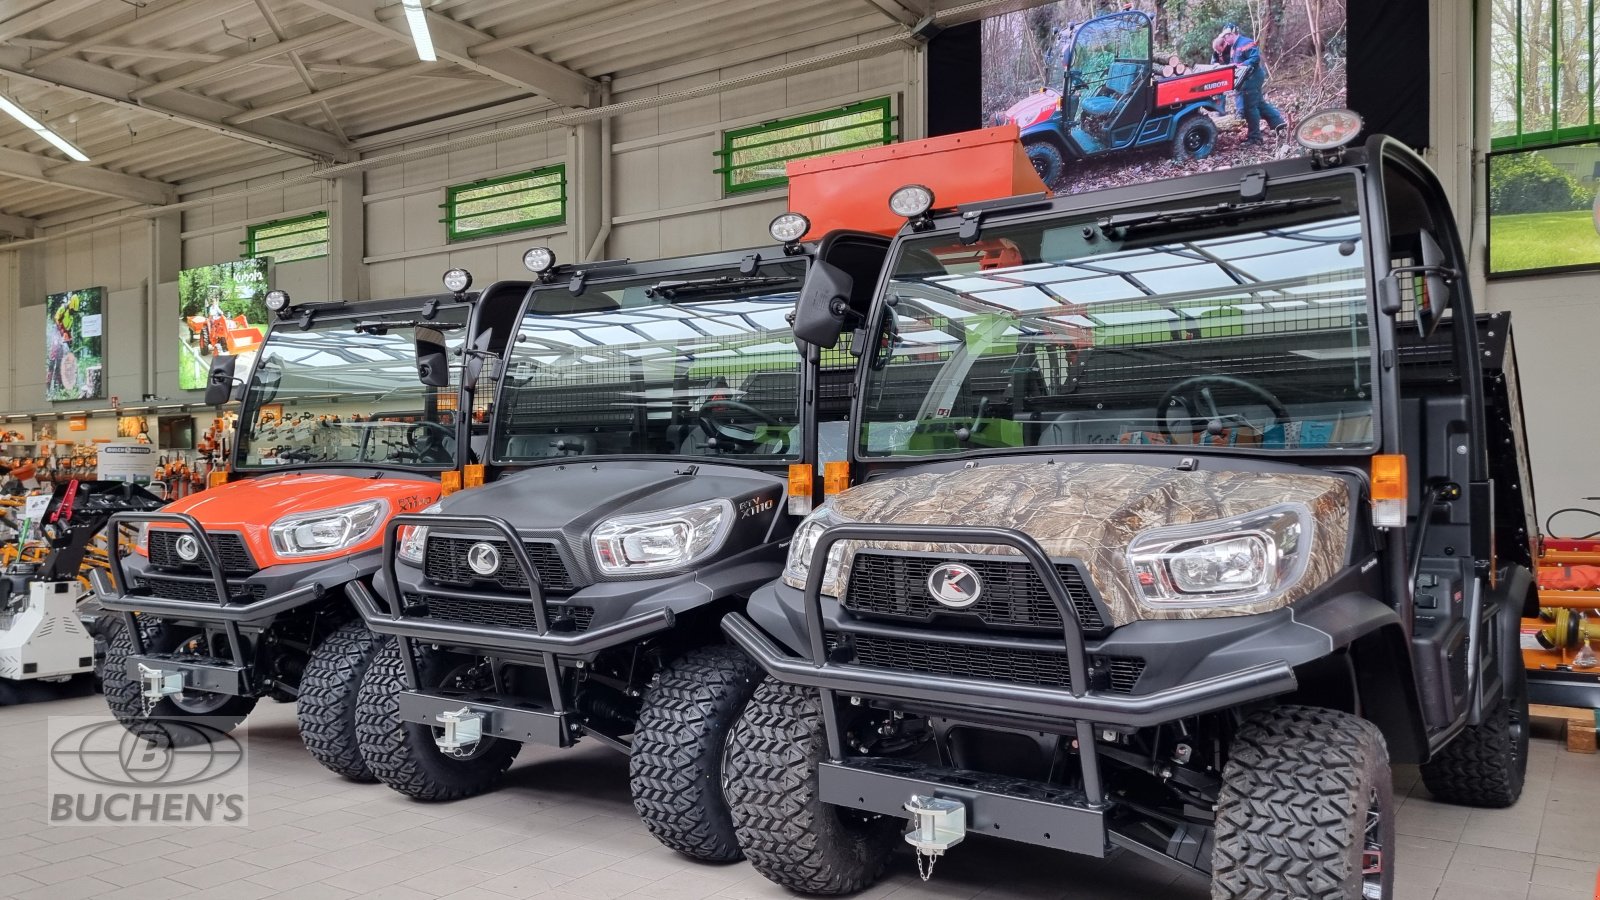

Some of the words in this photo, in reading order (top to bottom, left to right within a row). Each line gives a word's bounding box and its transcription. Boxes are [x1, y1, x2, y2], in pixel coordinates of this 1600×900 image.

[1204, 80, 1228, 91] KUBOTA
[739, 496, 760, 510] RTV
[741, 500, 773, 519] X1110
